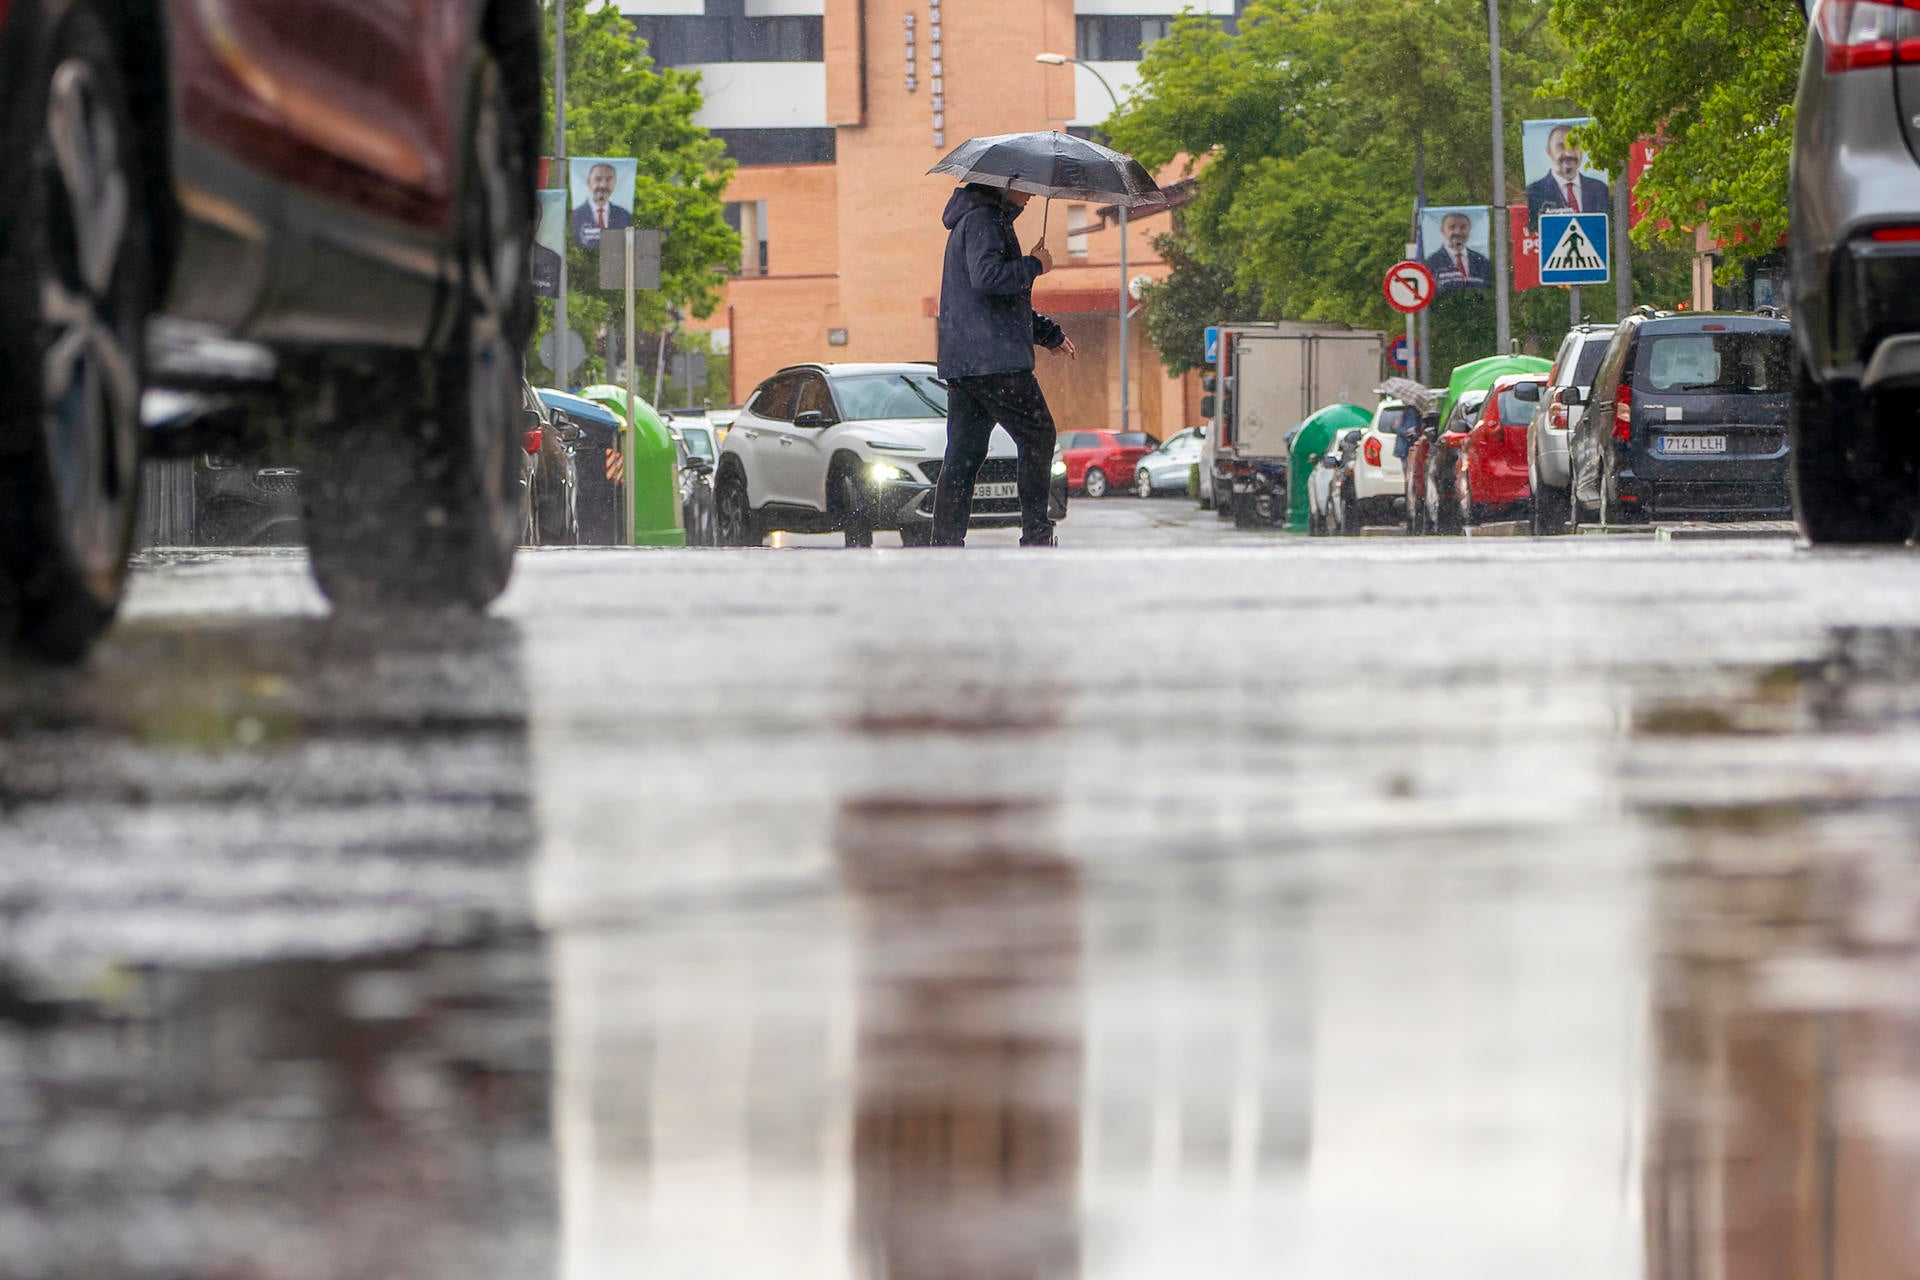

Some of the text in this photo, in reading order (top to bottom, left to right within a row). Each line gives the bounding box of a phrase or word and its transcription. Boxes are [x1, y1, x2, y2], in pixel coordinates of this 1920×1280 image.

[1666, 438, 1723, 449] 7141 LLH
[994, 484, 1015, 496] LNV
